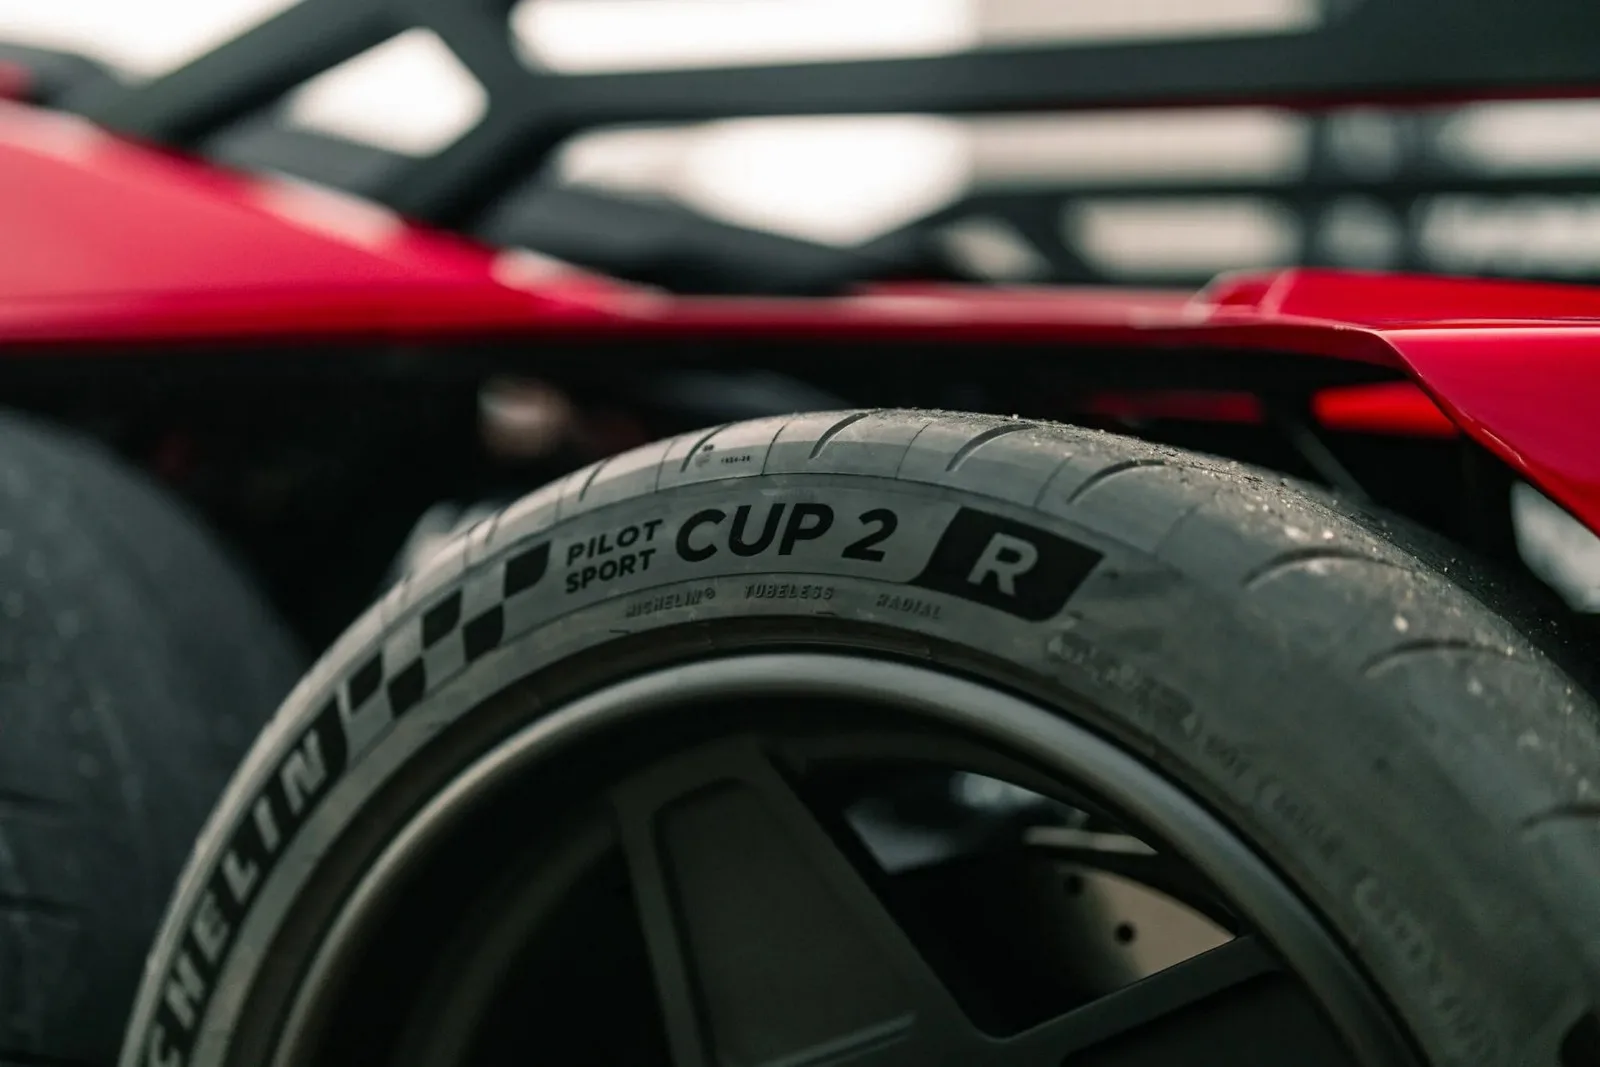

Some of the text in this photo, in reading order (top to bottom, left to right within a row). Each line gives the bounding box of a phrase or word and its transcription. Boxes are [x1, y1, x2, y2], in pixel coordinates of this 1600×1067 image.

[566, 518, 663, 567] PILOT
[675, 502, 1039, 596] CUP 2 R
[564, 548, 656, 594] SPORT
[743, 583, 835, 600] TUBELESS
[875, 592, 943, 621] RADIAL
